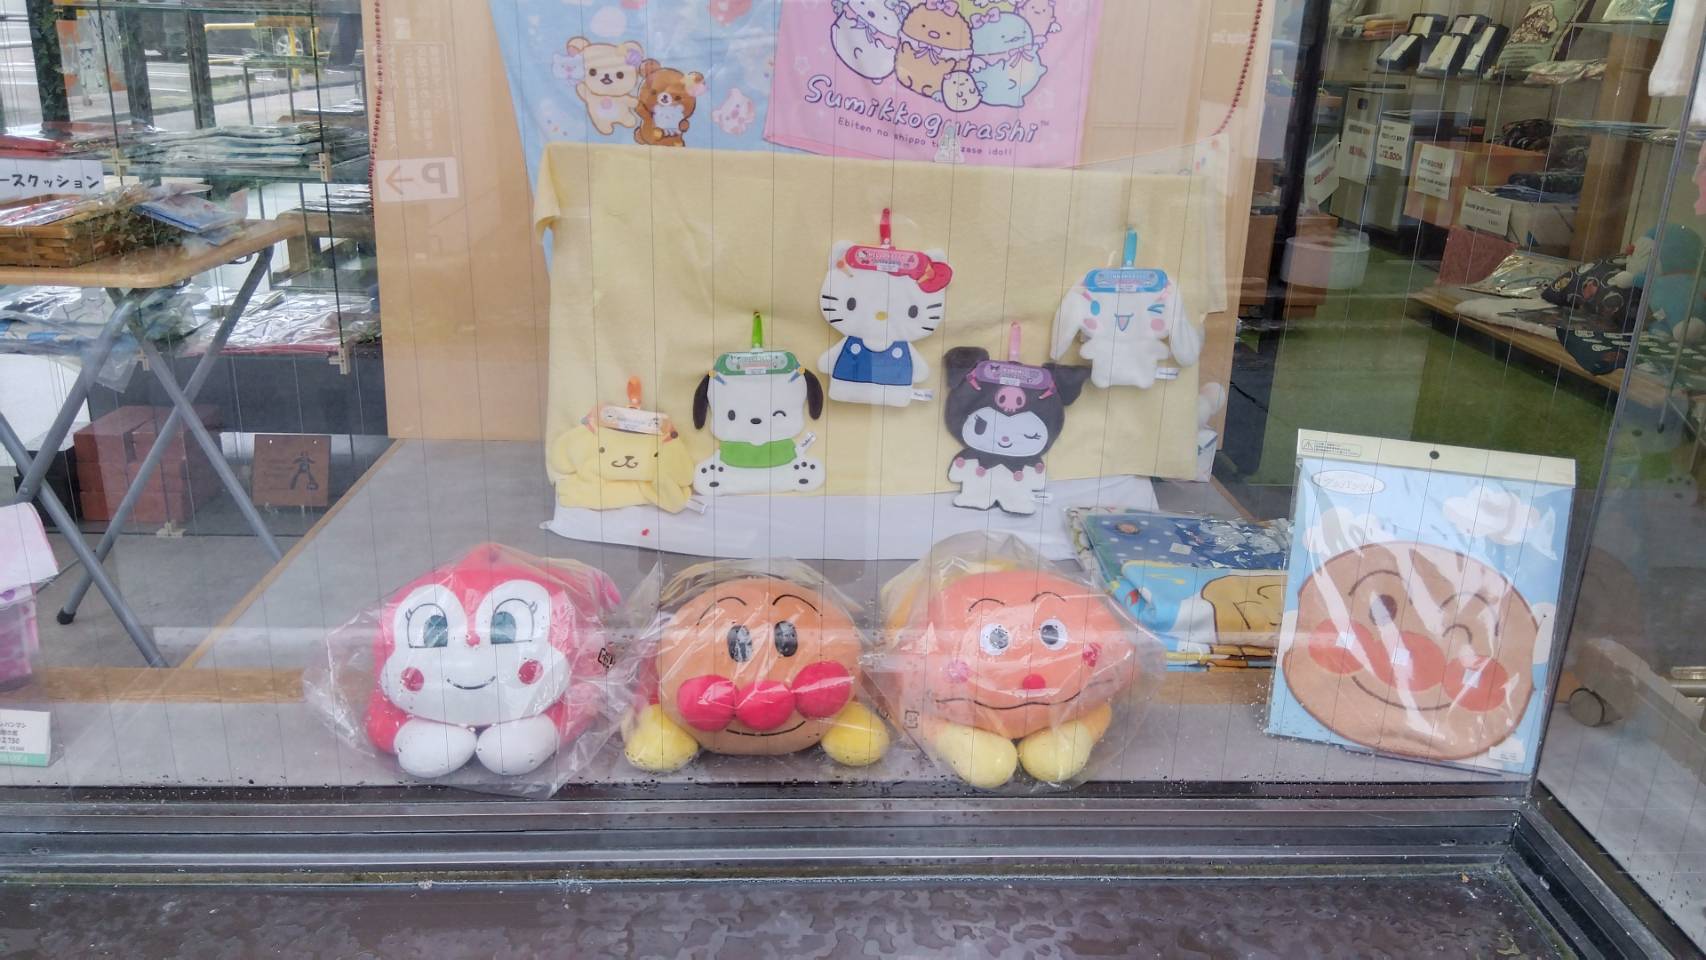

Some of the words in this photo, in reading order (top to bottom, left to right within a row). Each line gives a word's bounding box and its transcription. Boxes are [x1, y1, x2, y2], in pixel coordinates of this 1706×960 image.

[838, 116, 872, 132] Ebiten
[877, 128, 888, 136] no
[894, 132, 926, 146] shippo
